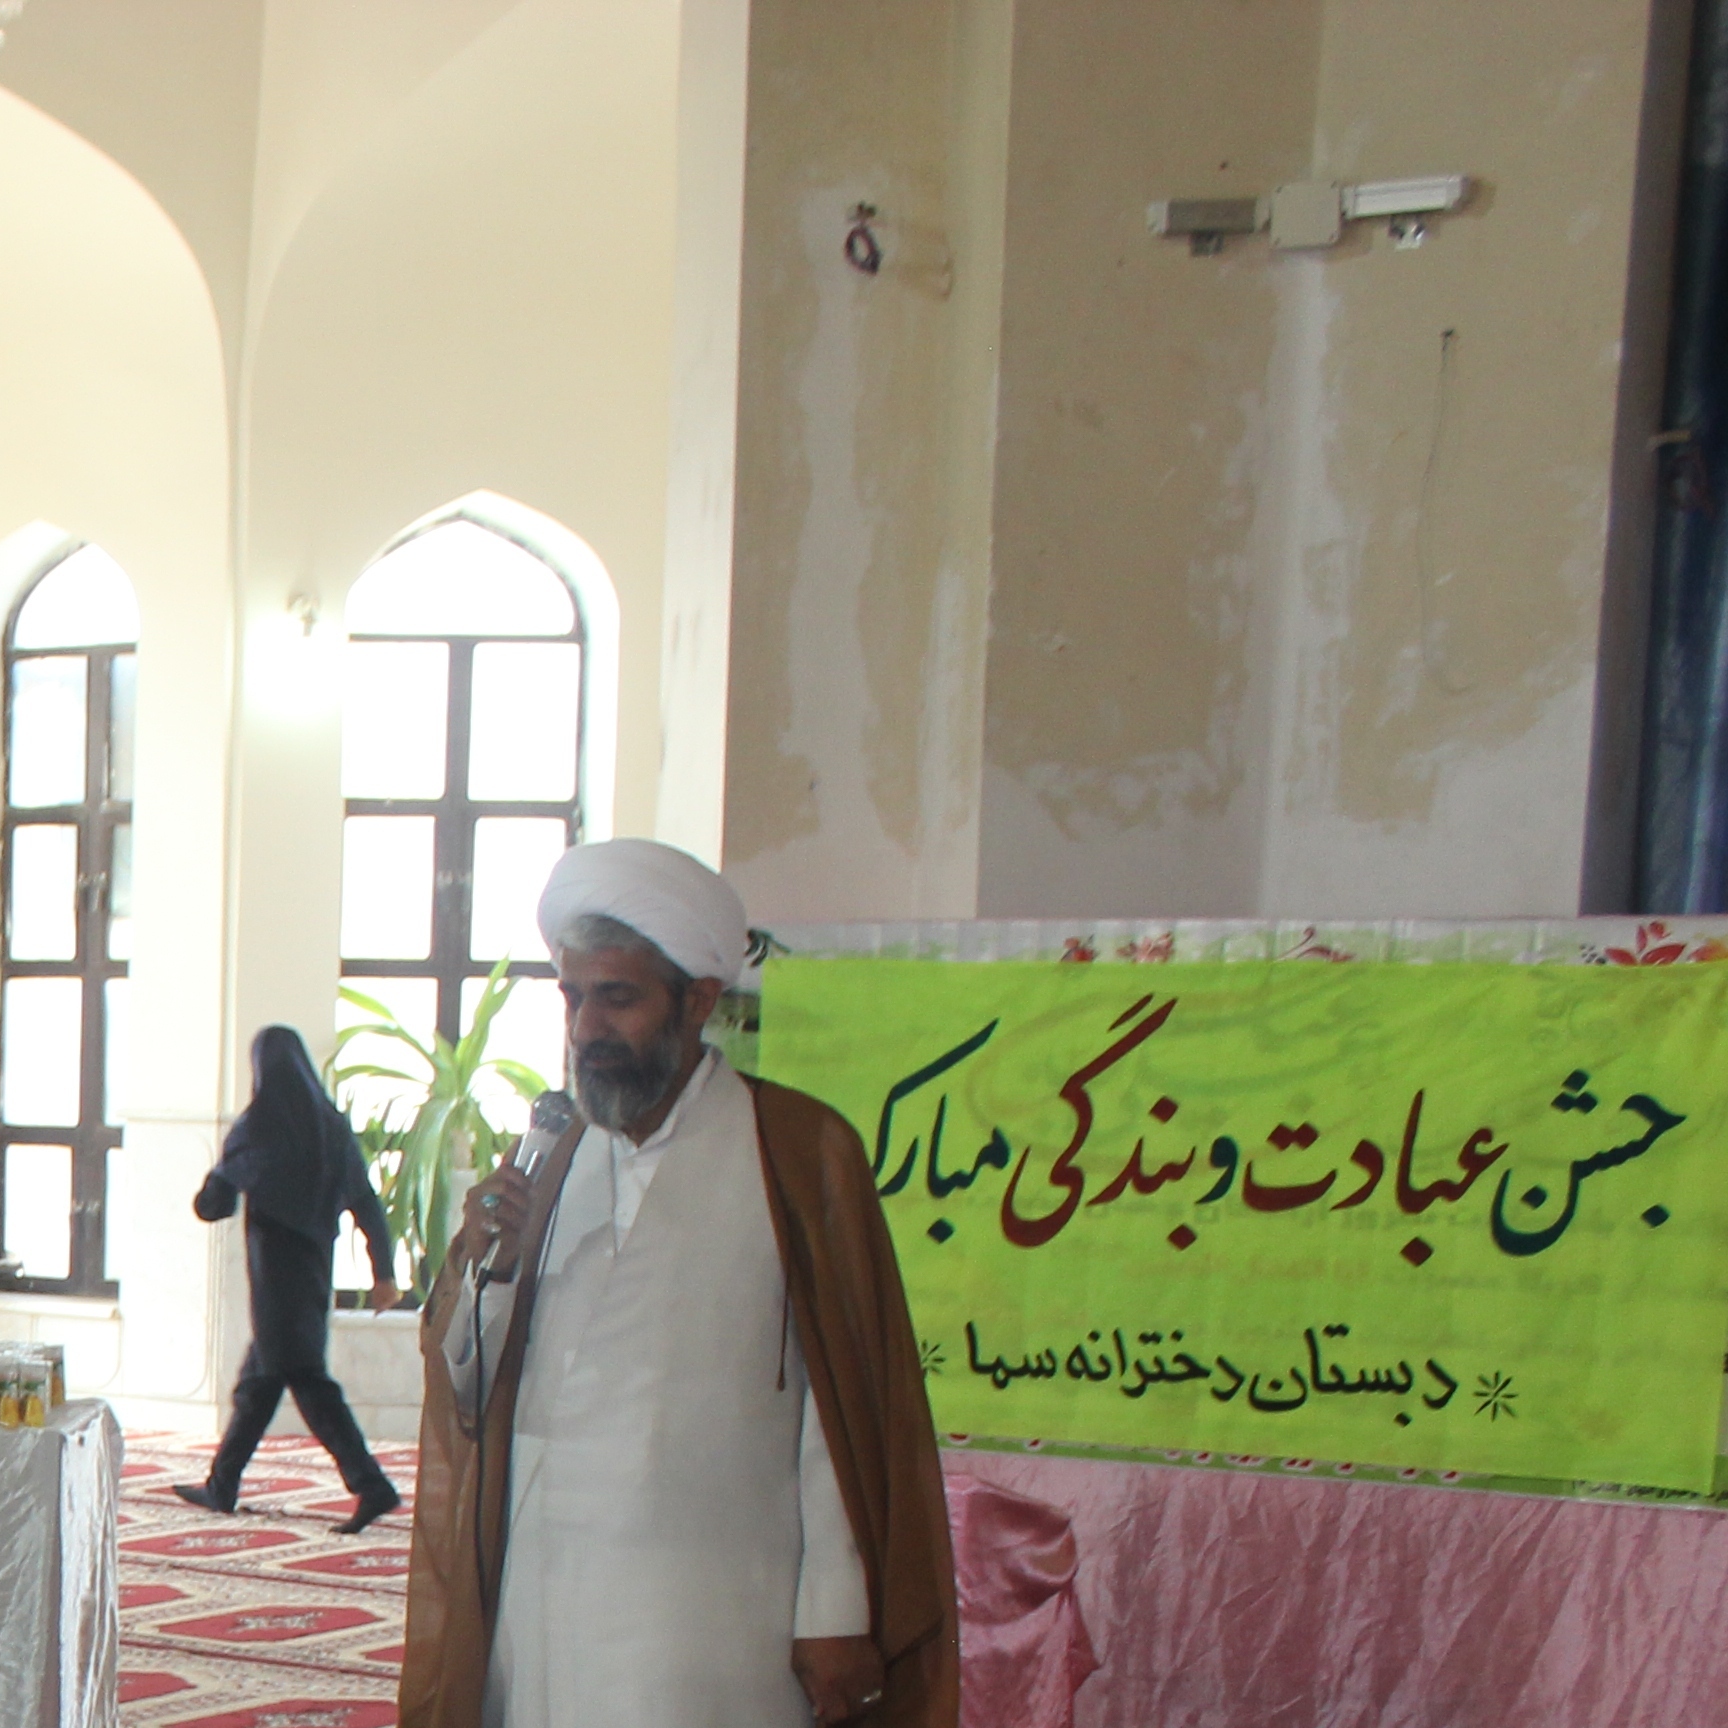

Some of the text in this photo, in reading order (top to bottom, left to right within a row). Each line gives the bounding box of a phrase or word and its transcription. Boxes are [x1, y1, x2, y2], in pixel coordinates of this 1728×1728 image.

[872, 992, 1688, 1268] جشن عبادت و بندگی مبارک
[963, 1320, 1459, 1428] دبستان دخترانه سما
